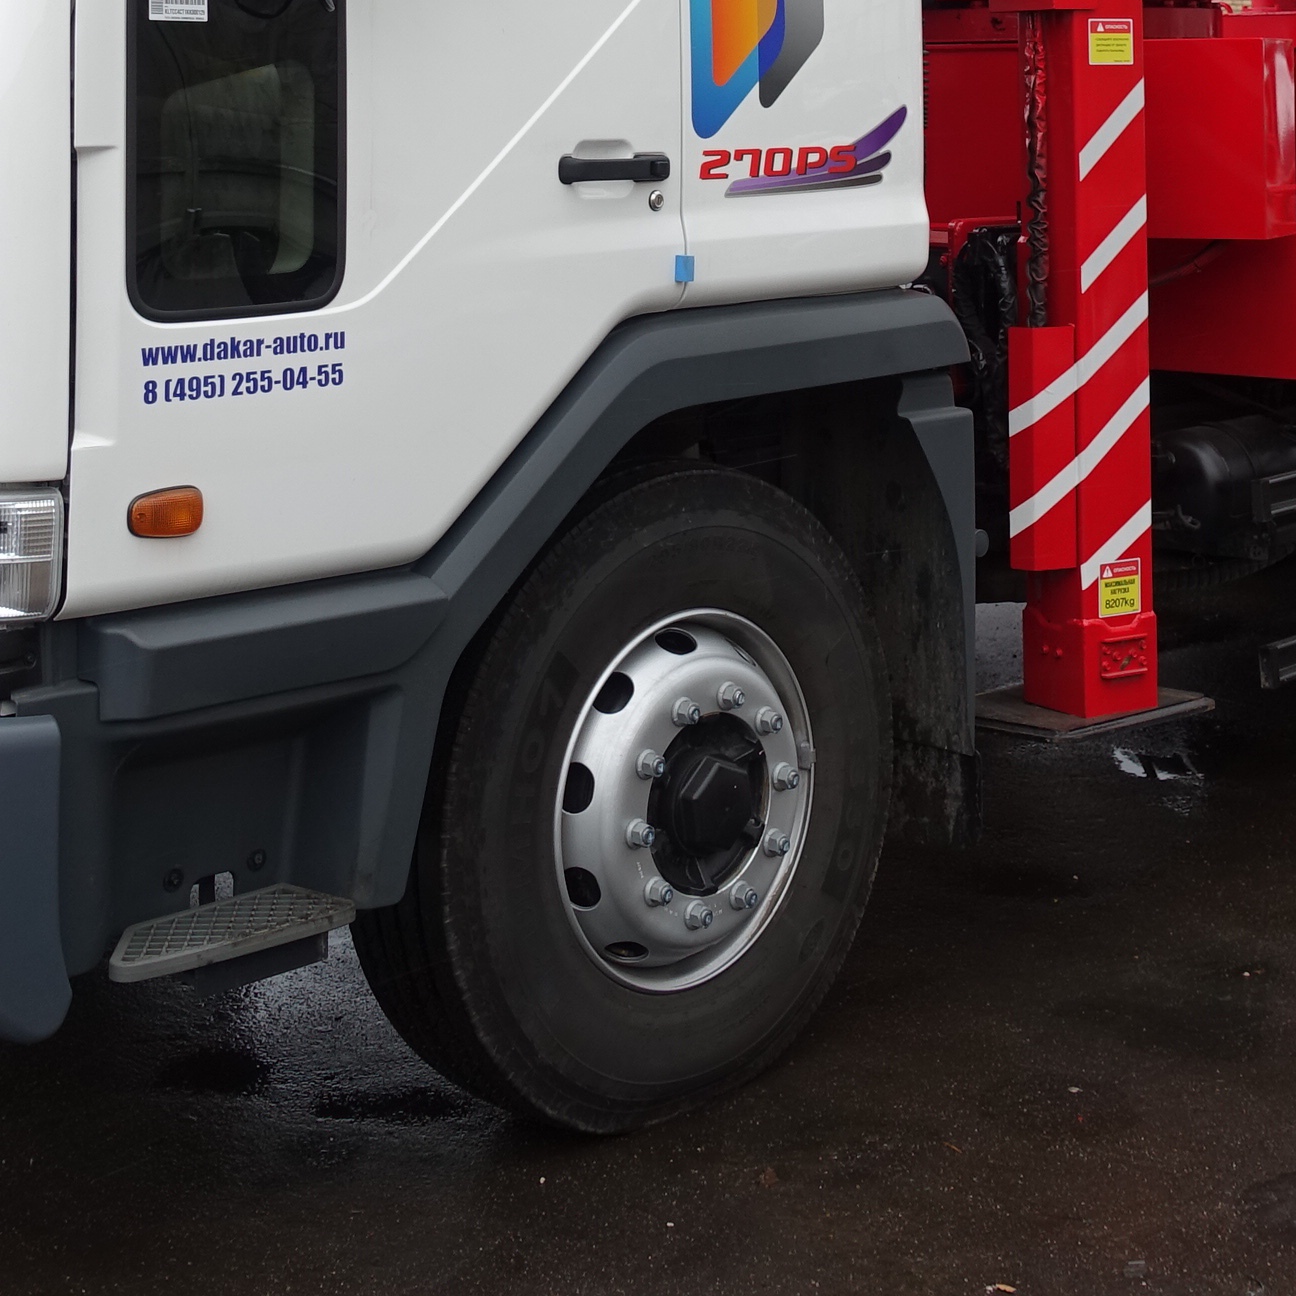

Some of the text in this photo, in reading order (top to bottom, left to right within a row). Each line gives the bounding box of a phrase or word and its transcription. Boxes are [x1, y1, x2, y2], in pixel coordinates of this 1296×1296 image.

[699, 144, 858, 180] 270PS
[141, 331, 346, 367] www.dakar-auto.ru
[143, 362, 344, 404] 8 (495) 255-04-55
